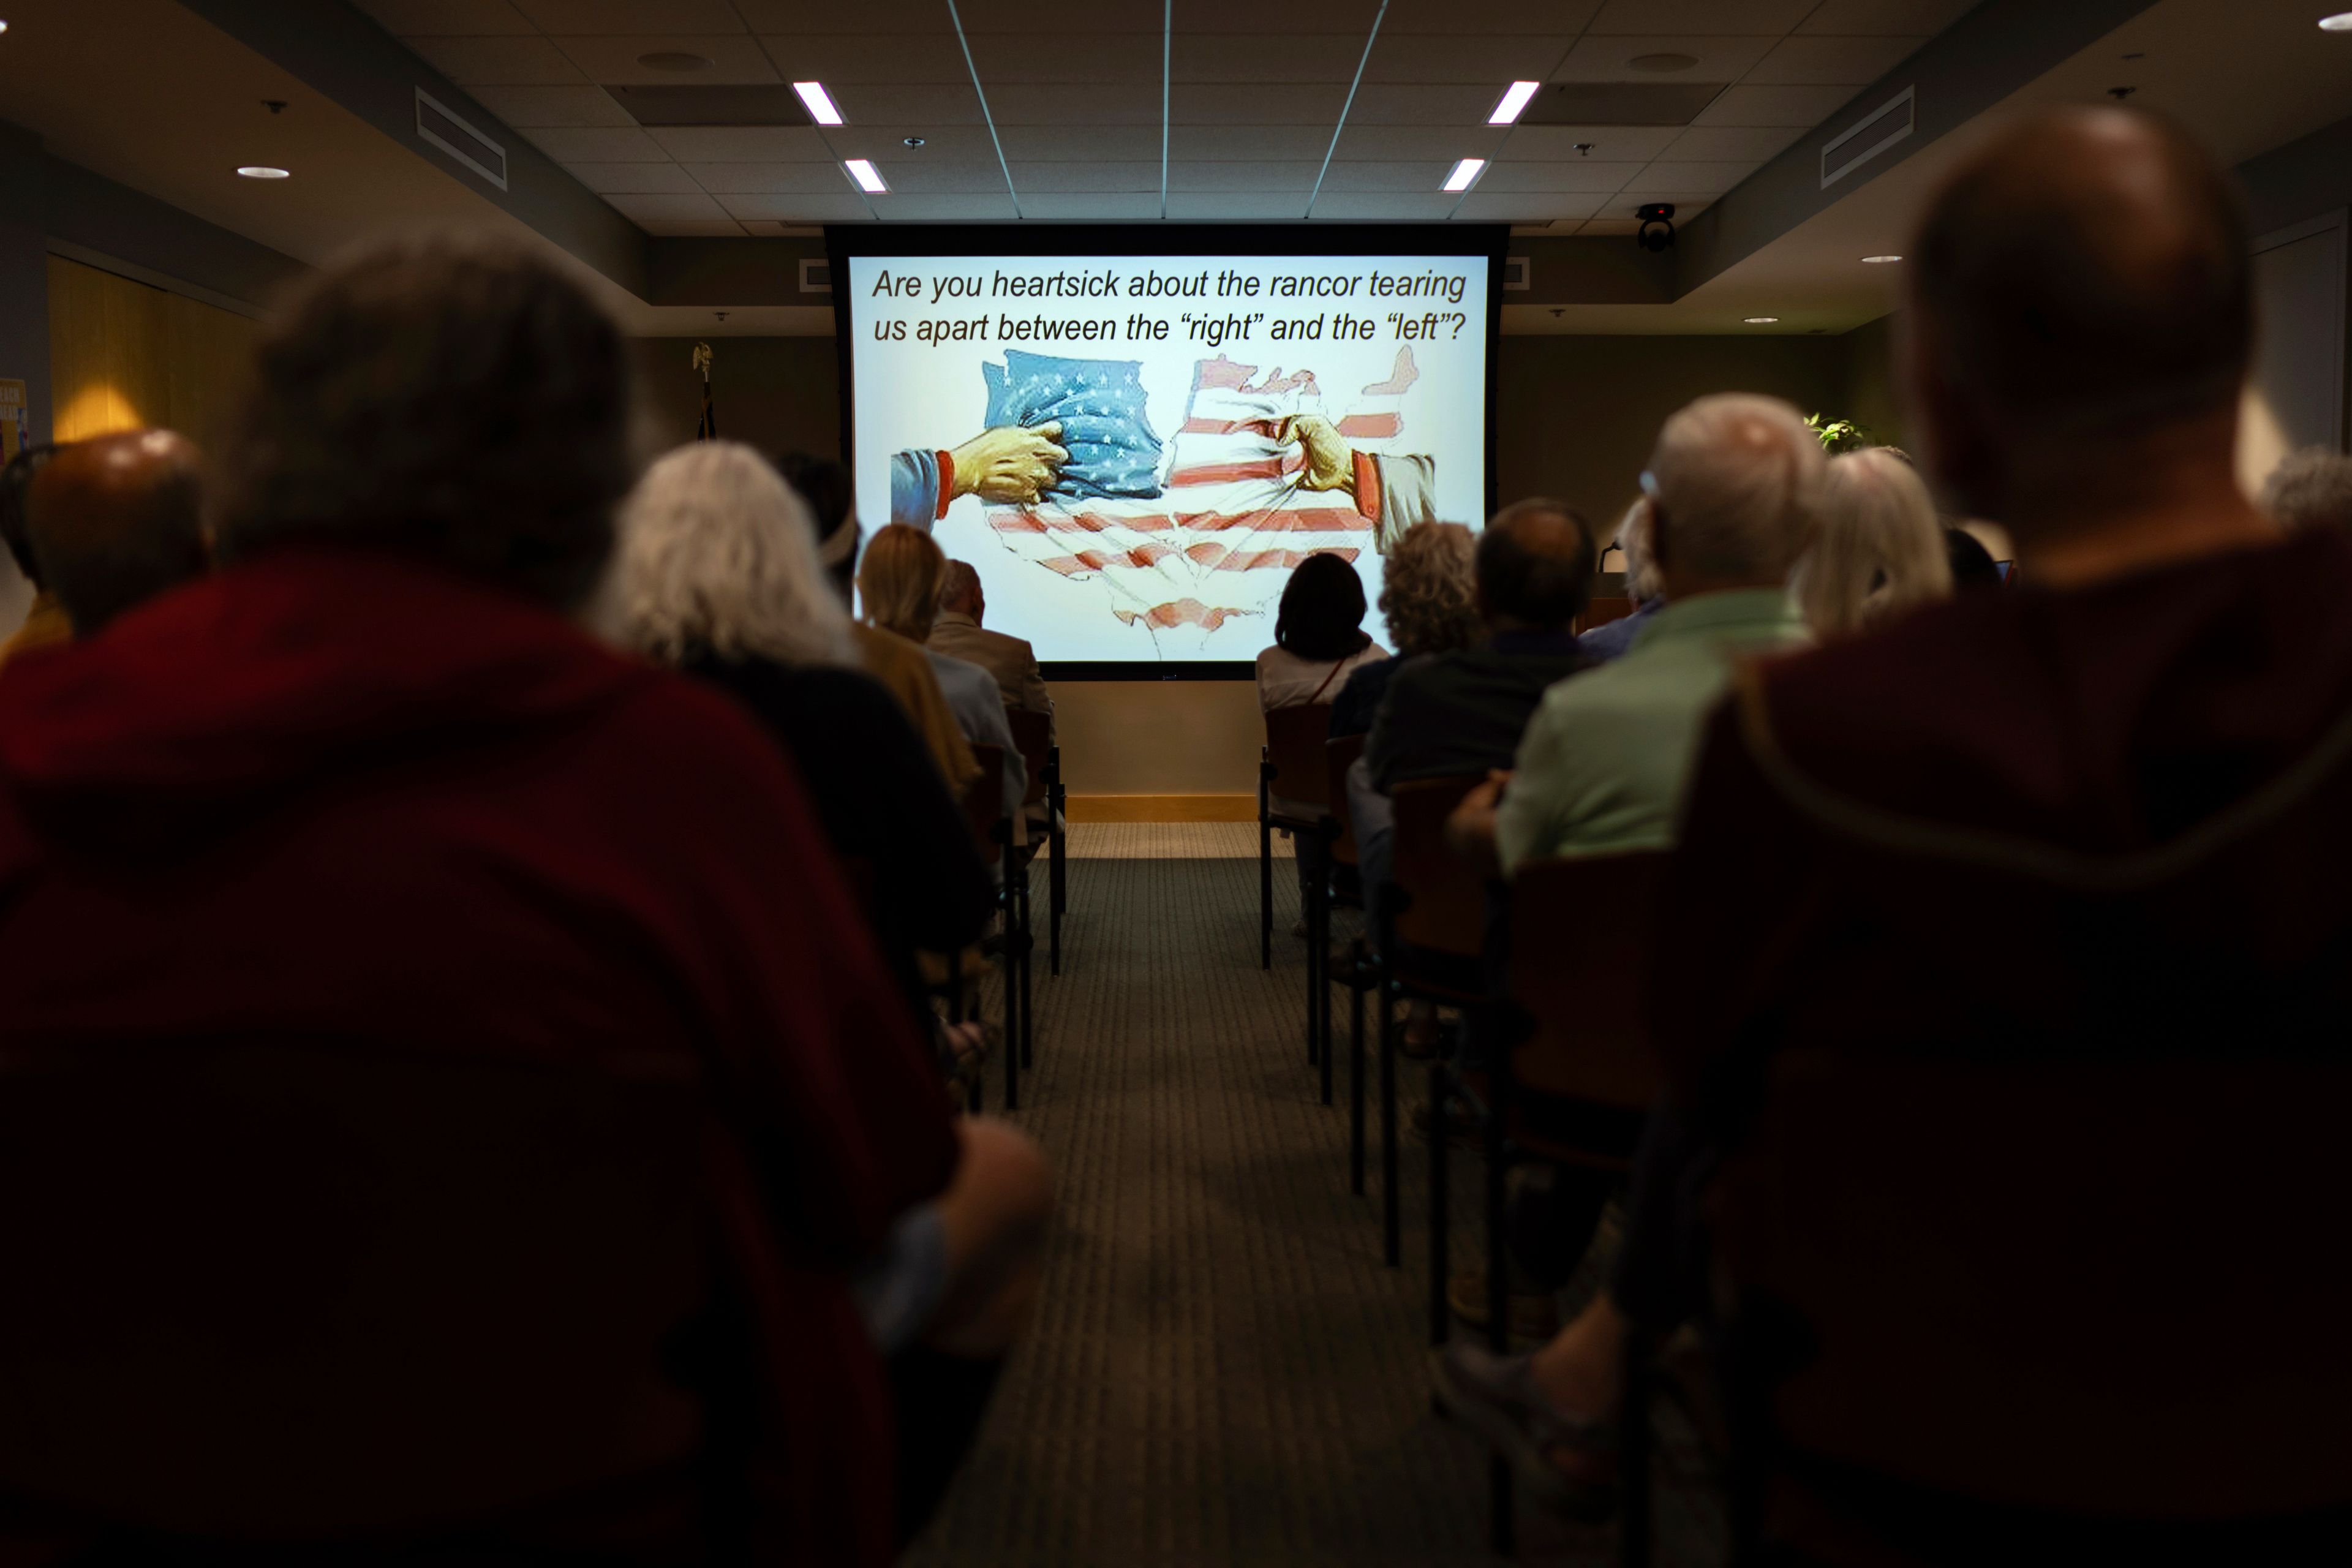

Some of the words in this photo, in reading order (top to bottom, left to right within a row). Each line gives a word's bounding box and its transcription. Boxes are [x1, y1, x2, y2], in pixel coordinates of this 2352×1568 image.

[872, 270, 921, 296] Are
[931, 277, 982, 304] you
[992, 270, 1120, 296] heartsick
[1129, 270, 1208, 296] about
[1218, 270, 1260, 296] the
[1270, 276, 1362, 296] rancor
[1370, 270, 1466, 303] tearing
[875, 320, 907, 341] us
[917, 314, 989, 347] apart
[998, 314, 1116, 340] between
[1127, 314, 1169, 340] the
[1182, 314, 1264, 347] “right”
[1271, 314, 1324, 340] and
[1333, 314, 1375, 339] the
[1388, 313, 1466, 339] “left”?
